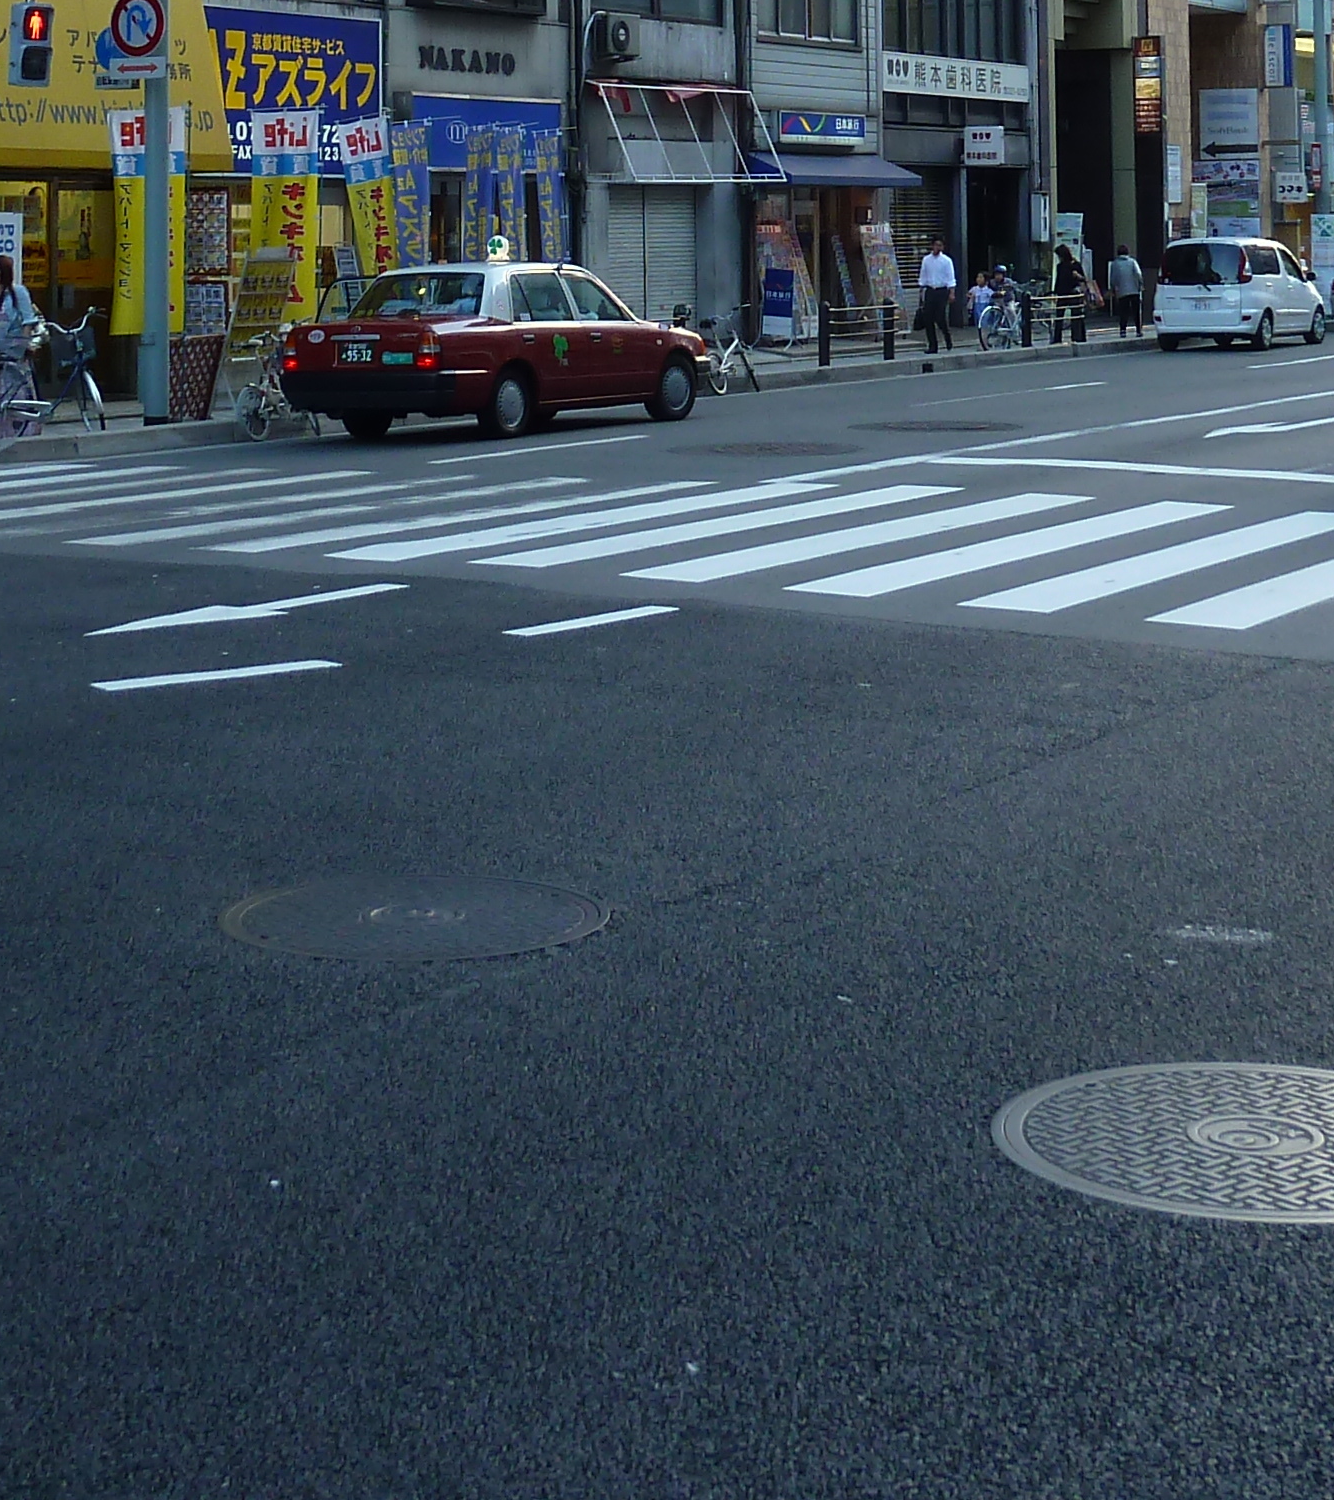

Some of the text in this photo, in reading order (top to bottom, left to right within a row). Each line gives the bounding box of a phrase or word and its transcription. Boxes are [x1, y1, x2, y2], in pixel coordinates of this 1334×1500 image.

[251, 32, 345, 56] 京都賃貸住宅サービス
[419, 46, 516, 75] NAKANO
[252, 53, 377, 111] アズライフ
[914, 61, 1002, 94] 熊本歯科医院
[836, 118, 859, 130] 日本旅行
